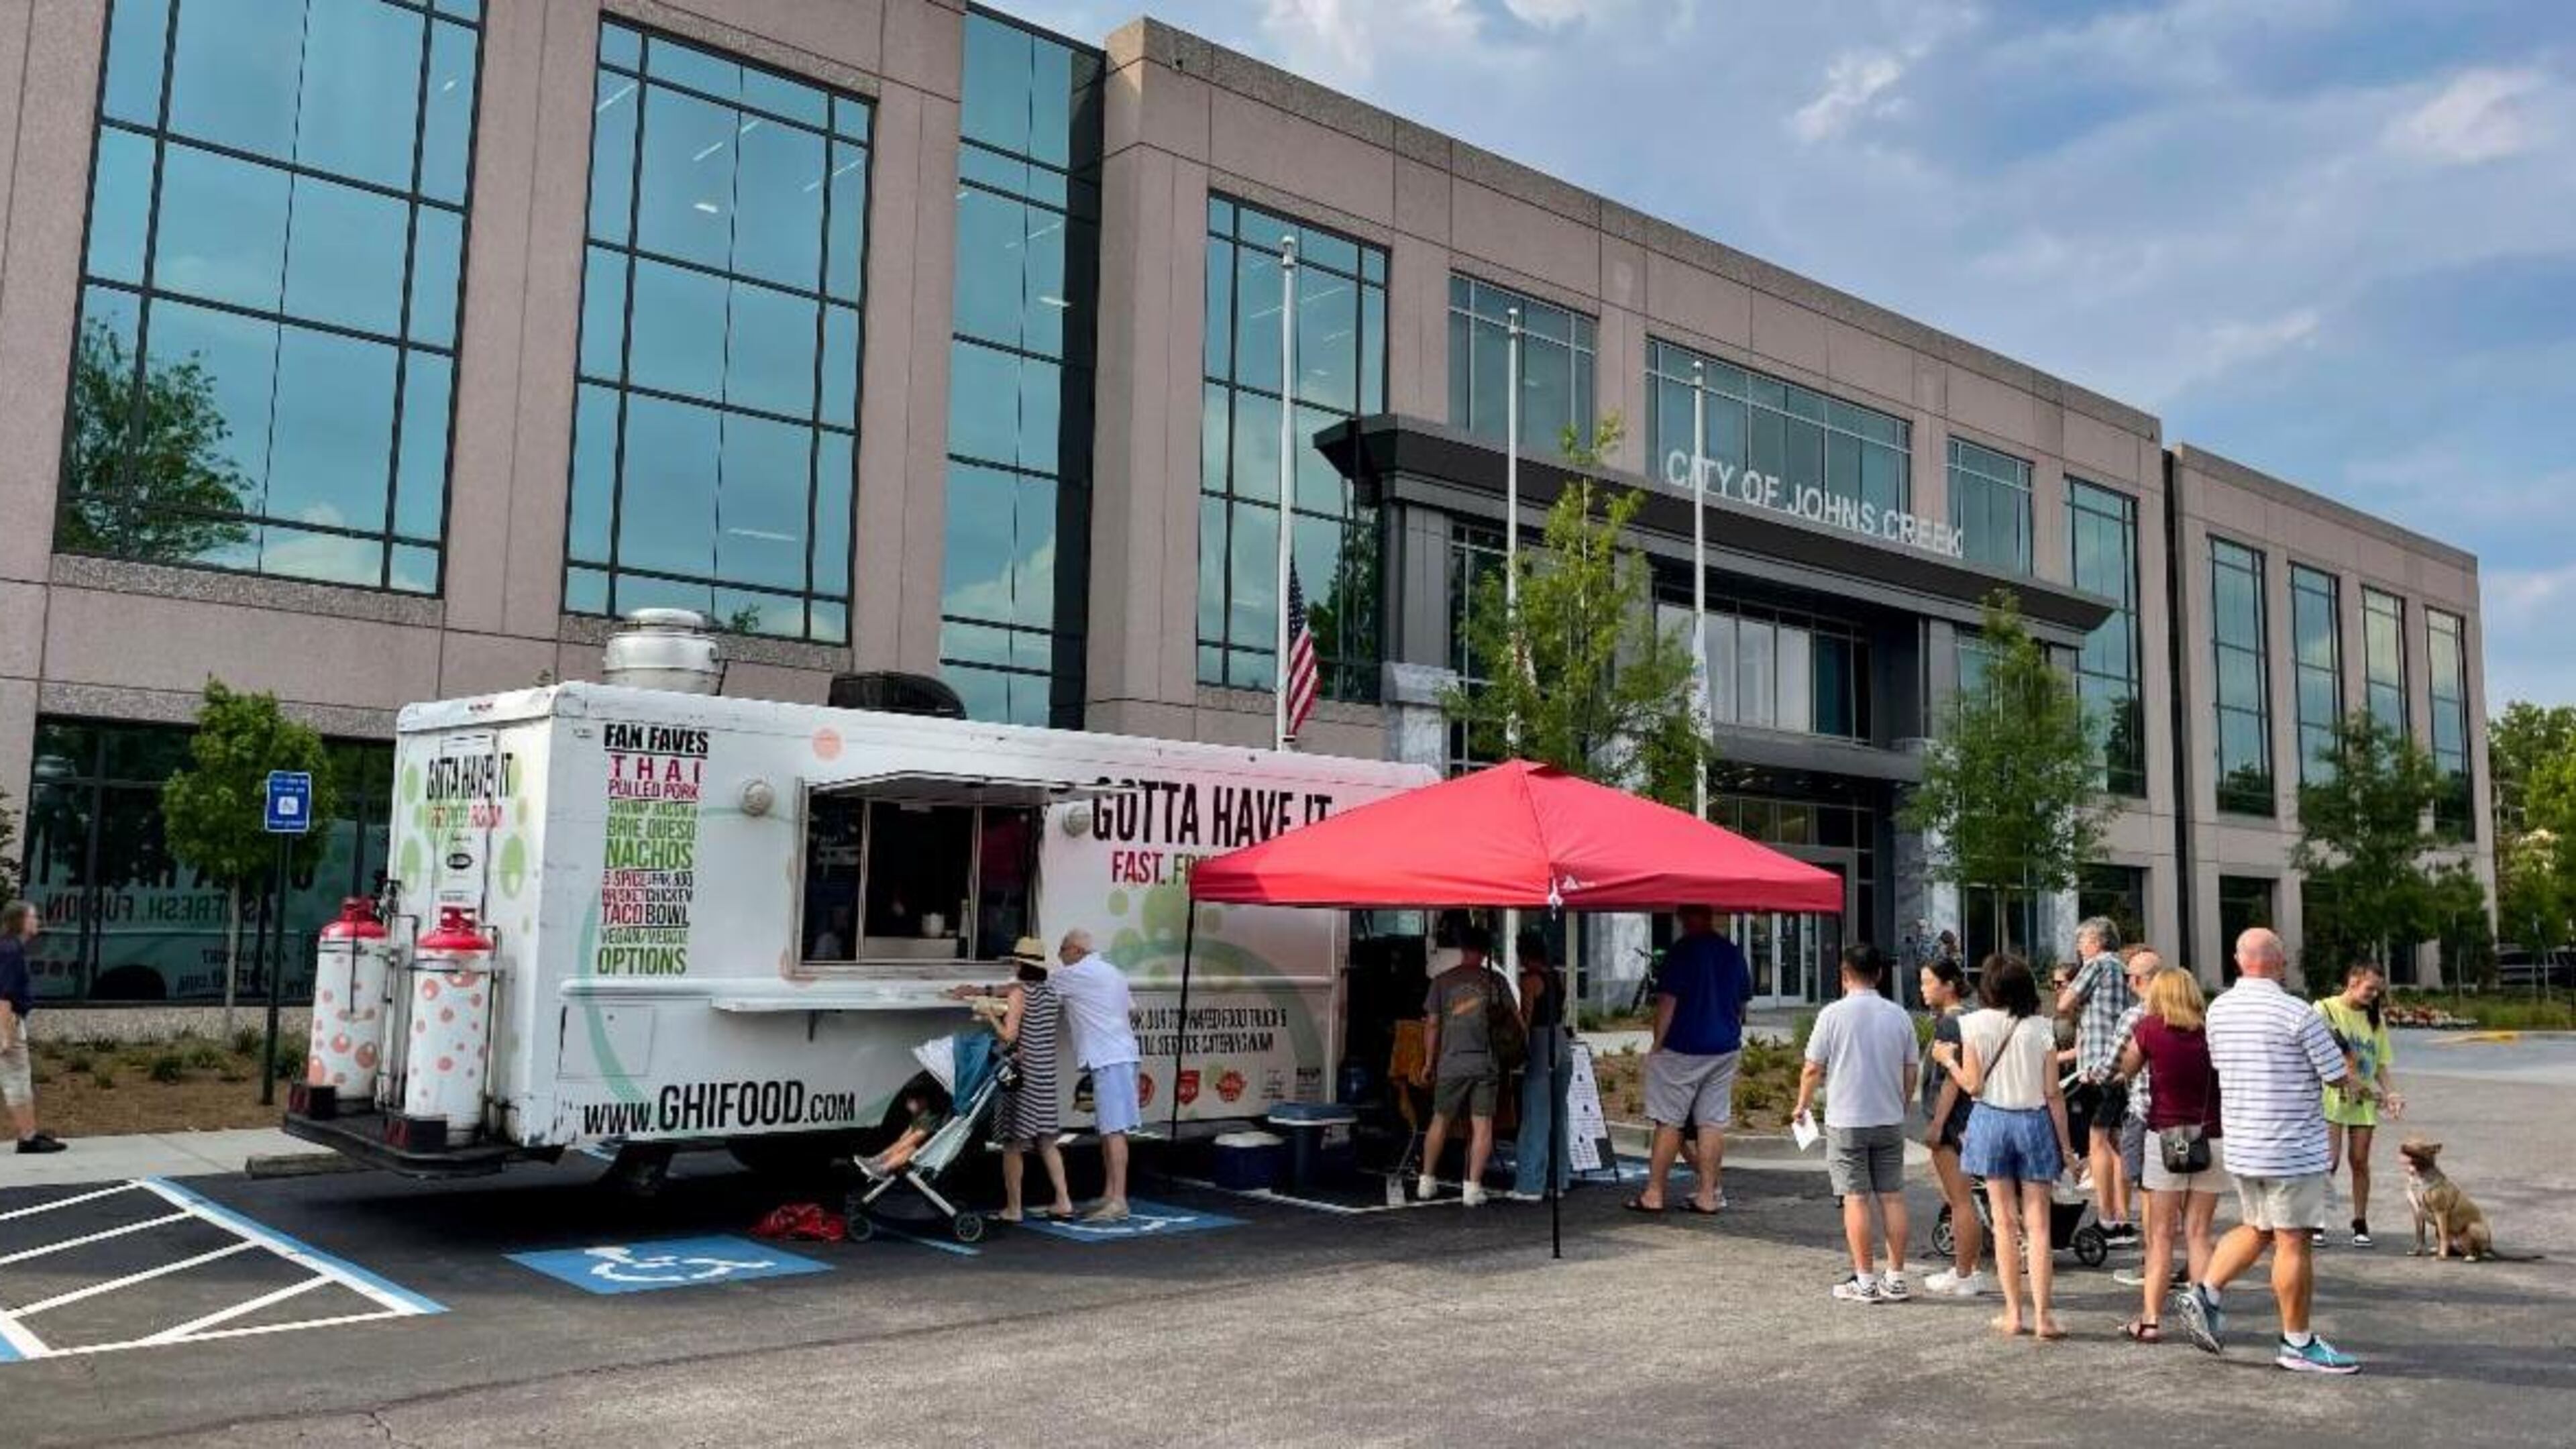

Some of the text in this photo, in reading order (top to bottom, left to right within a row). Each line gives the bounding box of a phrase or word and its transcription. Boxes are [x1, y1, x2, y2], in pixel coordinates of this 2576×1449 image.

[1666, 448, 1964, 559] CITY OF JOHNS CREEK
[604, 724, 708, 754] FAN FAVES
[611, 755, 700, 785] THAI
[608, 778, 699, 800] PULLED PORK
[1093, 776, 1200, 845] GOTTA
[1212, 786, 1293, 848] HAVE
[606, 816, 695, 841] BRIE QUESO
[604, 839, 694, 870] NACHOS
[1112, 851, 1167, 885] FAST.
[602, 903, 643, 925] TACO
[645, 903, 690, 926] BOWL
[598, 947, 687, 975] OPTIONS
